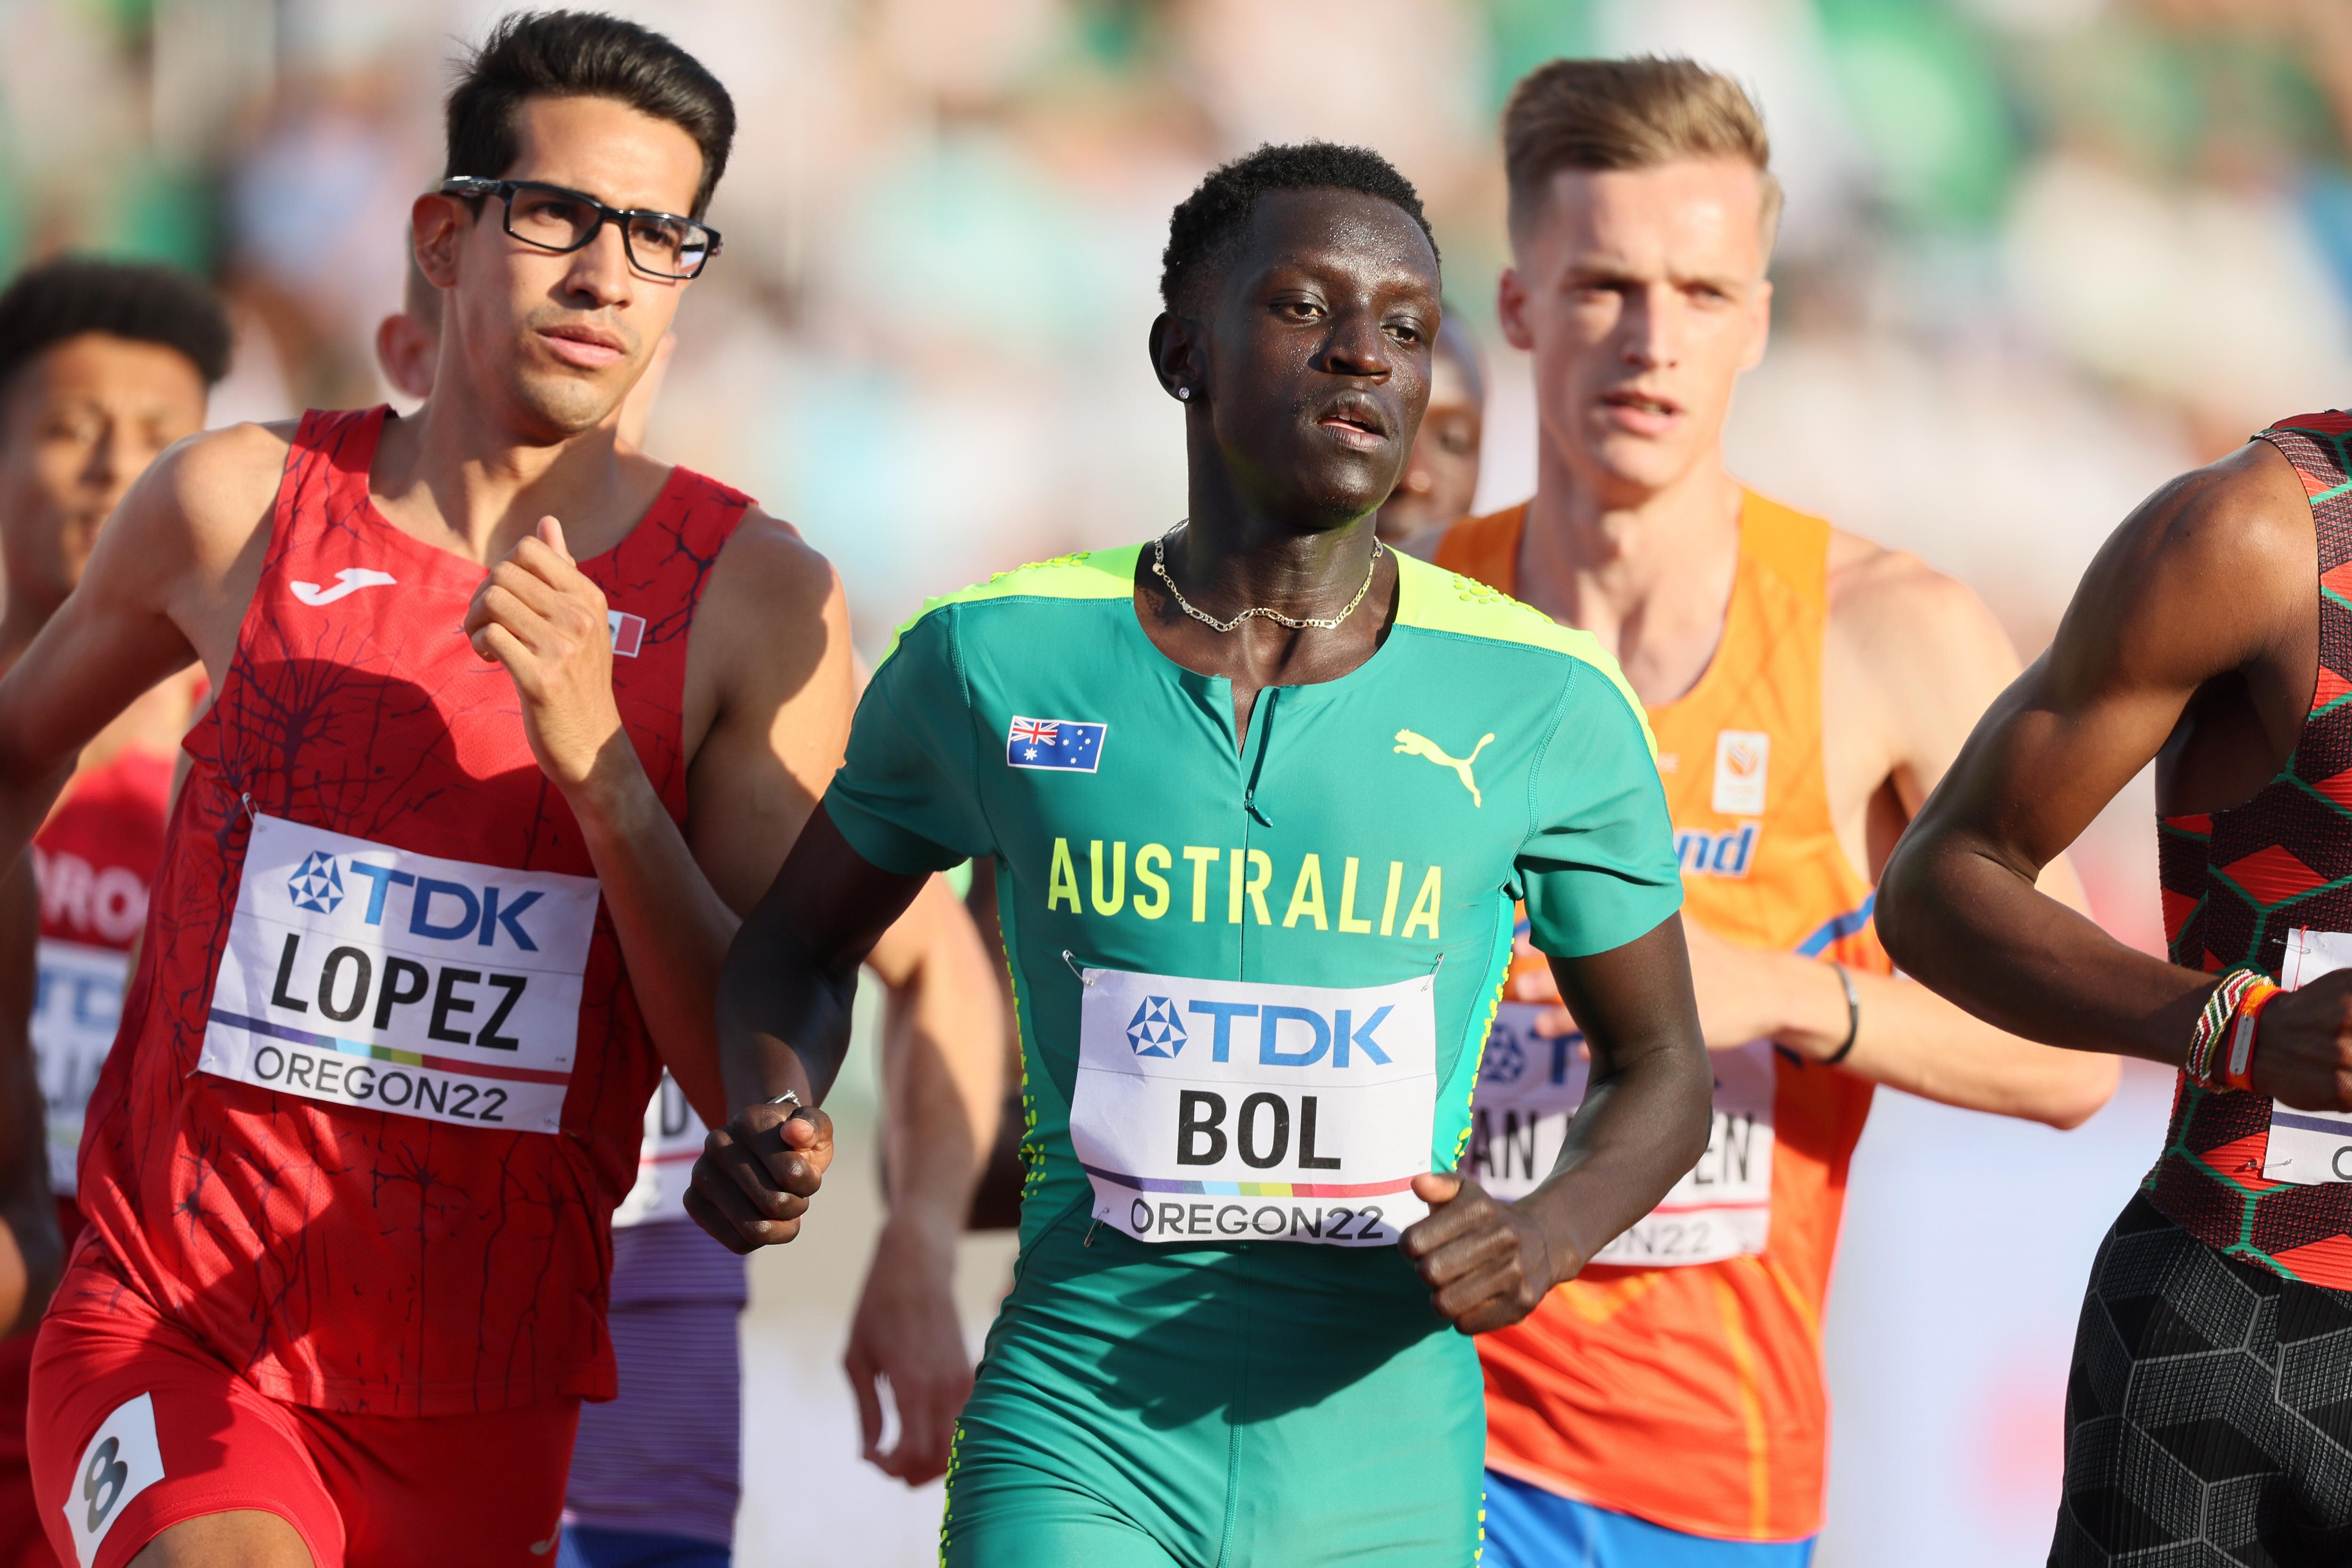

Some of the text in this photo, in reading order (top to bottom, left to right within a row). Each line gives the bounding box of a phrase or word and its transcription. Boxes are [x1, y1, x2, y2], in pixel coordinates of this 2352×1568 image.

[350, 861, 545, 951] TDK
[1048, 837, 1441, 939] AUSTRALIA
[270, 933, 527, 1051] LOPEZ
[1189, 1000, 1395, 1068] TDK
[254, 1046, 508, 1122] OREGON22
[1176, 1090, 1341, 1170] BOL
[1469, 1106, 1538, 1180] AN
[1130, 1198, 1383, 1240] OREGON22
[84, 1437, 127, 1533] 8
